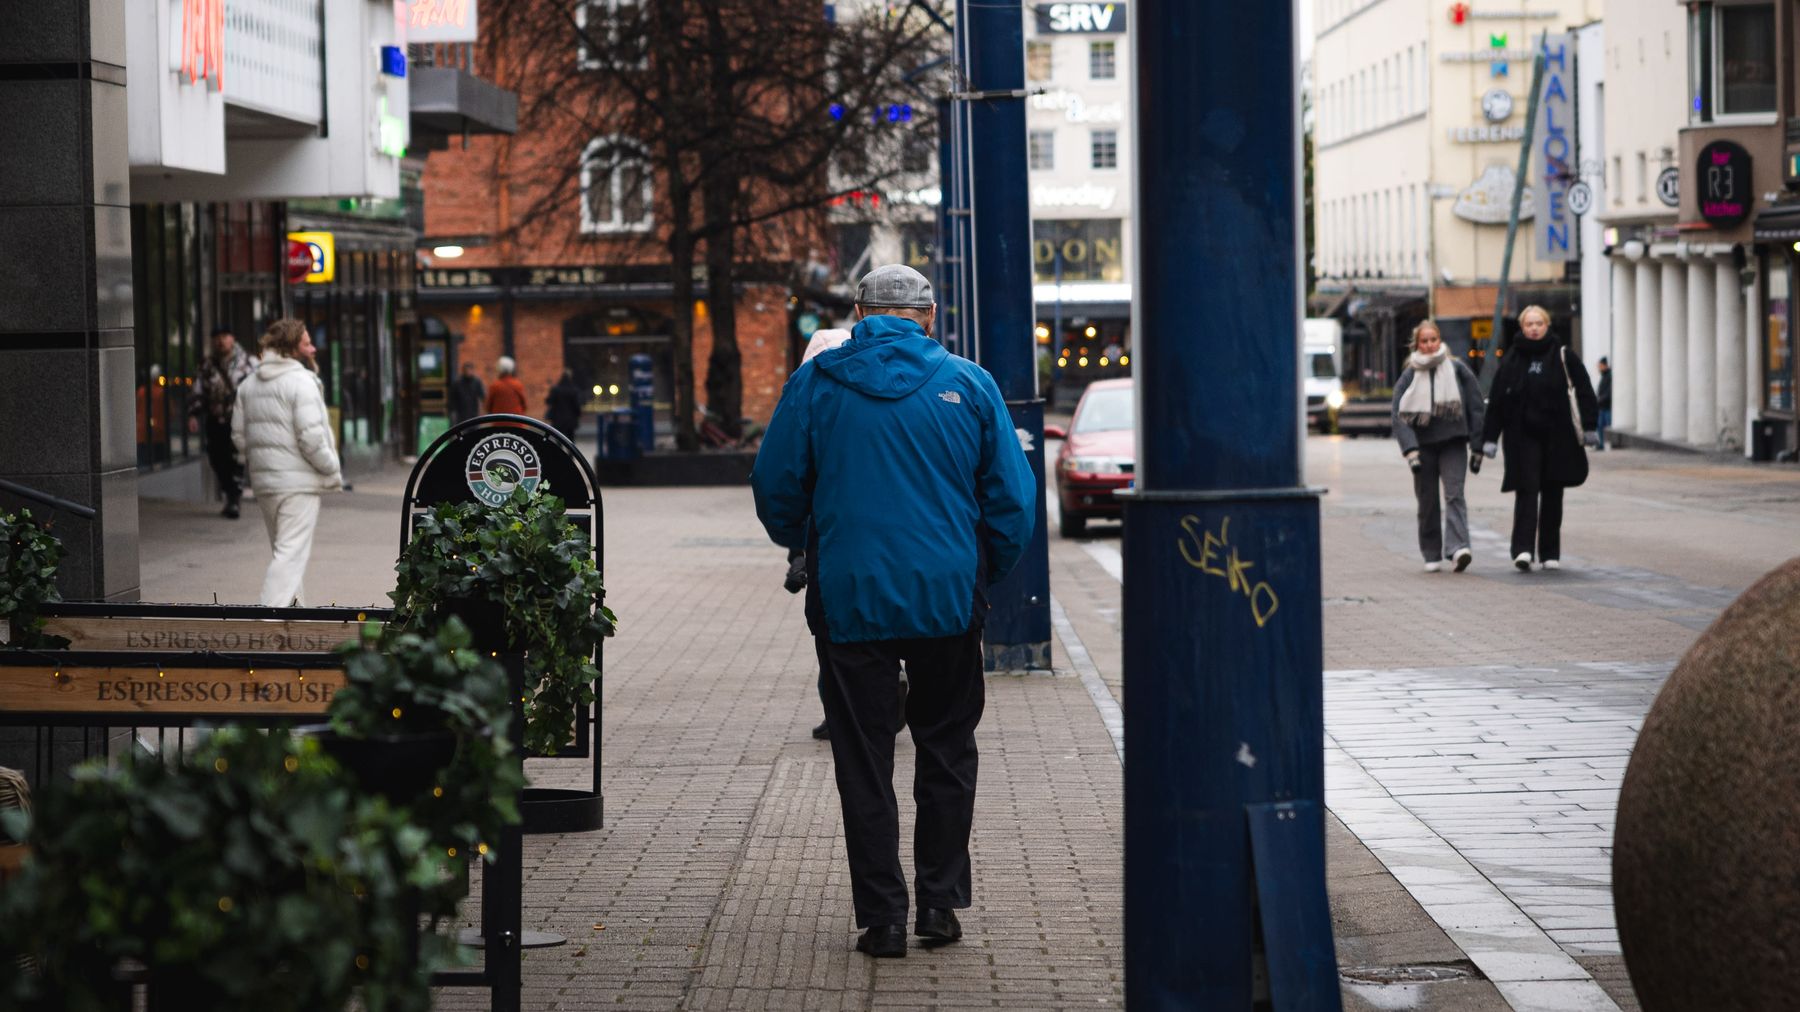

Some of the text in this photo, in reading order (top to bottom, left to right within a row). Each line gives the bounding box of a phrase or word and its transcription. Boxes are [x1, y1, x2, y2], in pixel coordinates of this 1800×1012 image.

[1049, 3, 1115, 31] SRV
[471, 438, 534, 467] ESPRESSO
[126, 629, 330, 651] ESPRESSO HOUSE
[97, 680, 232, 701] ESPRESSO
